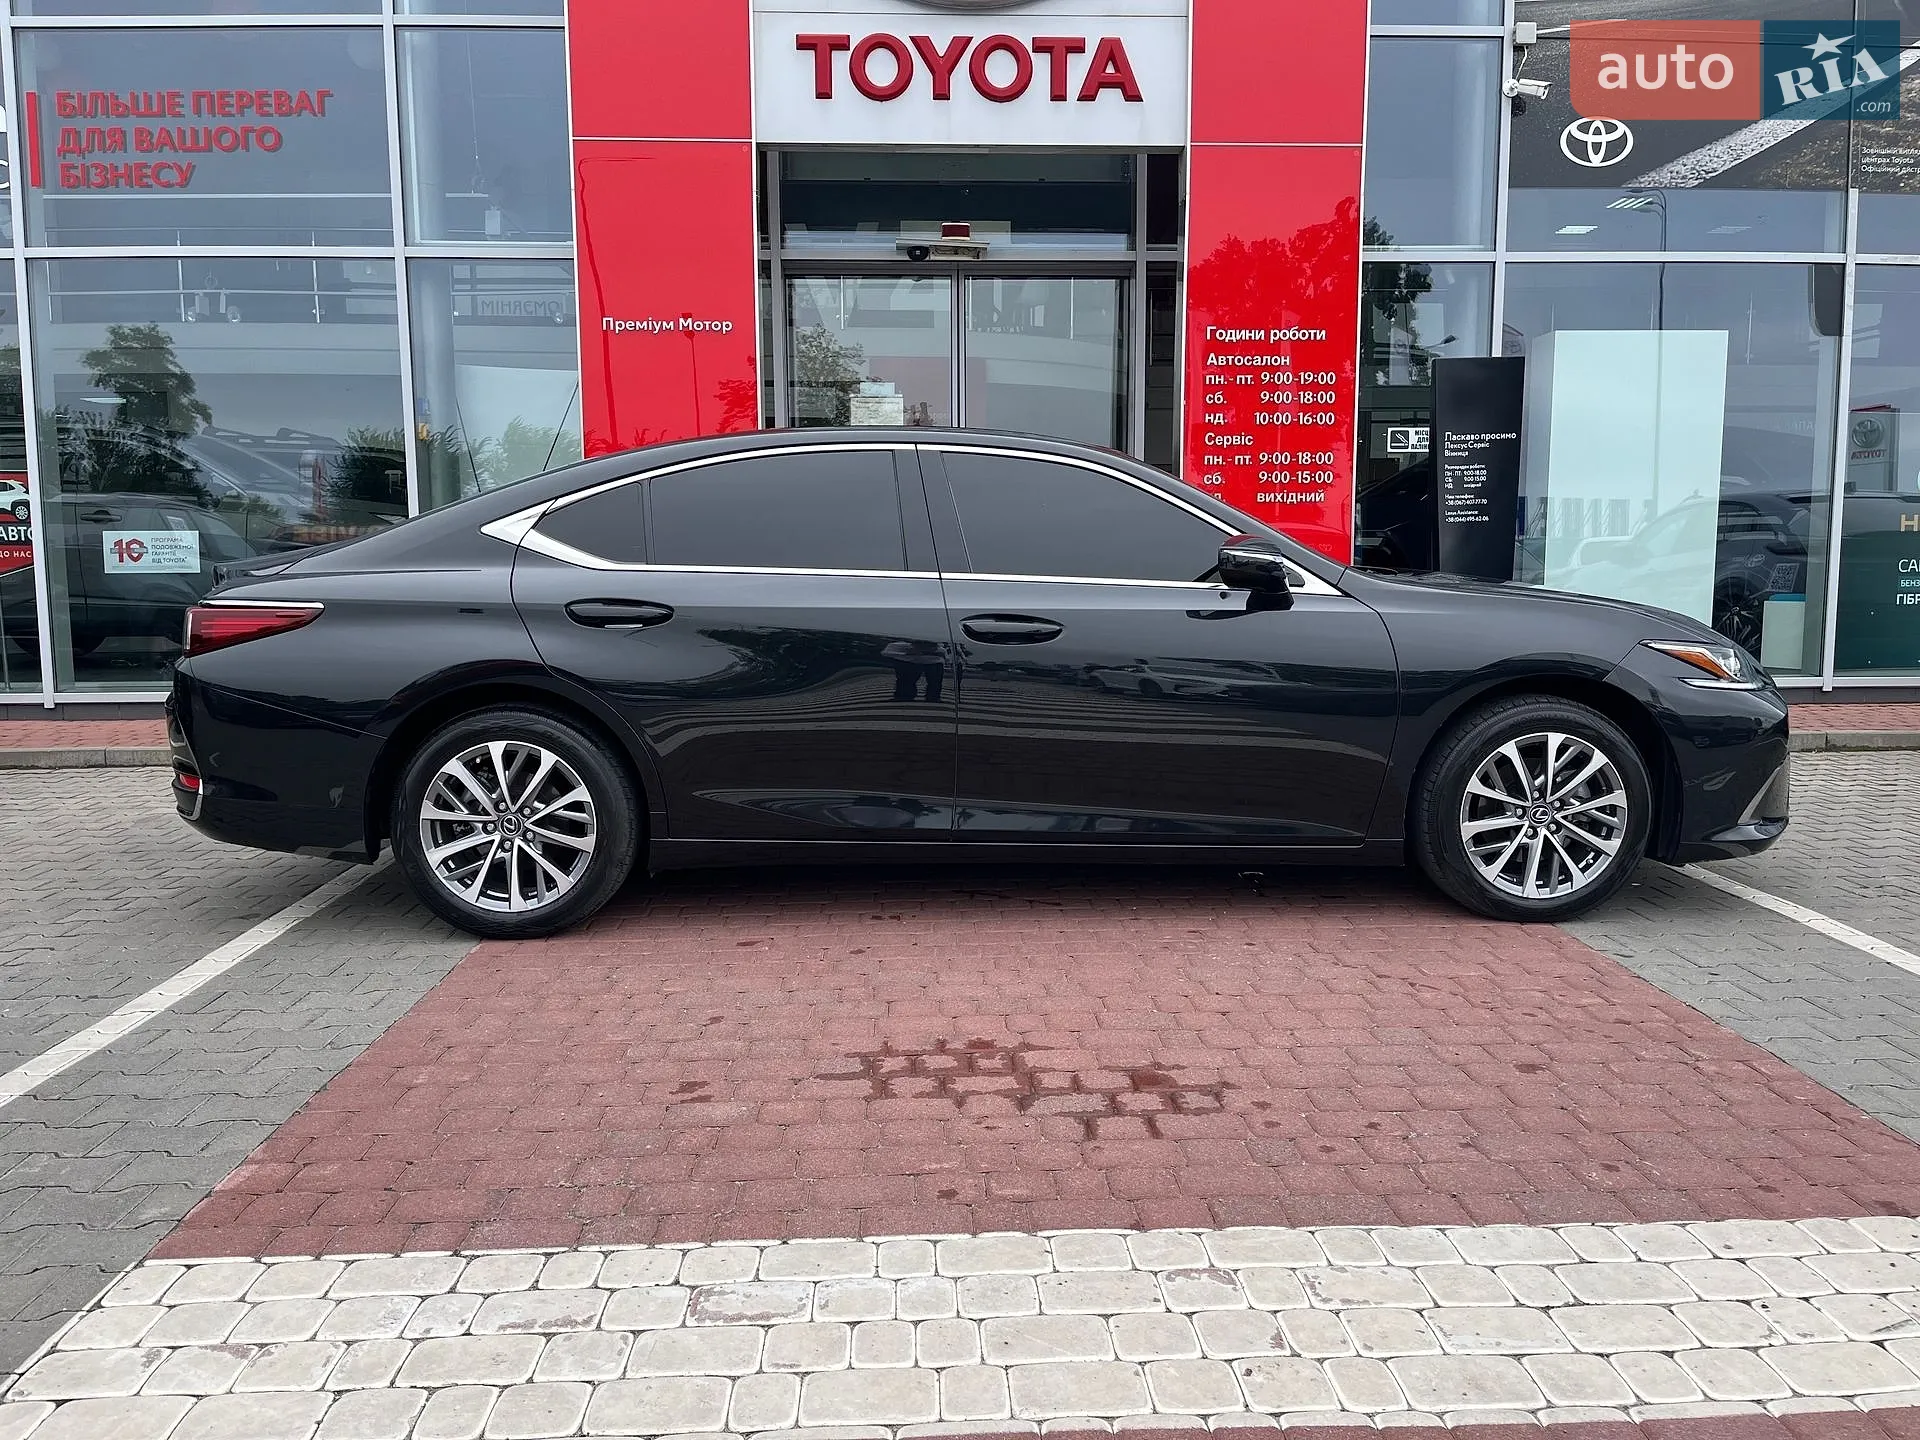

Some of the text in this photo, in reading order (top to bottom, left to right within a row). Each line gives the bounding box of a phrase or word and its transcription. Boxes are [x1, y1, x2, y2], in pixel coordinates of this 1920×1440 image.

[796, 33, 1144, 103] TOYOTA
[56, 89, 333, 119] БІЛЬШЕ ПЕРЕВАГ
[57, 124, 283, 157] ДЛЯ ВАШОГО
[1892, 157, 1914, 165] Toyota
[59, 161, 195, 189] БІЗНЕСУ
[602, 316, 733, 336] Преміум Мотор
[1205, 326, 1326, 344] Години роботи
[1206, 353, 1290, 367] Автосалон
[1260, 371, 1336, 385] 9:00-19:00
[1205, 391, 1336, 404] сб. 9:00-18:00
[1205, 412, 1335, 425] нд. 10:00-16:00
[1204, 432, 1254, 448] Сервіс
[1444, 432, 1517, 441] Ласкаво просимо
[1444, 441, 1490, 449] Лексус Сервіс
[1258, 452, 1334, 465] 9:00-18:00
[1203, 471, 1334, 485] сб. 9:00-15:00
[1256, 489, 1325, 503] вихідний
[13, 550, 32, 558] НАС
